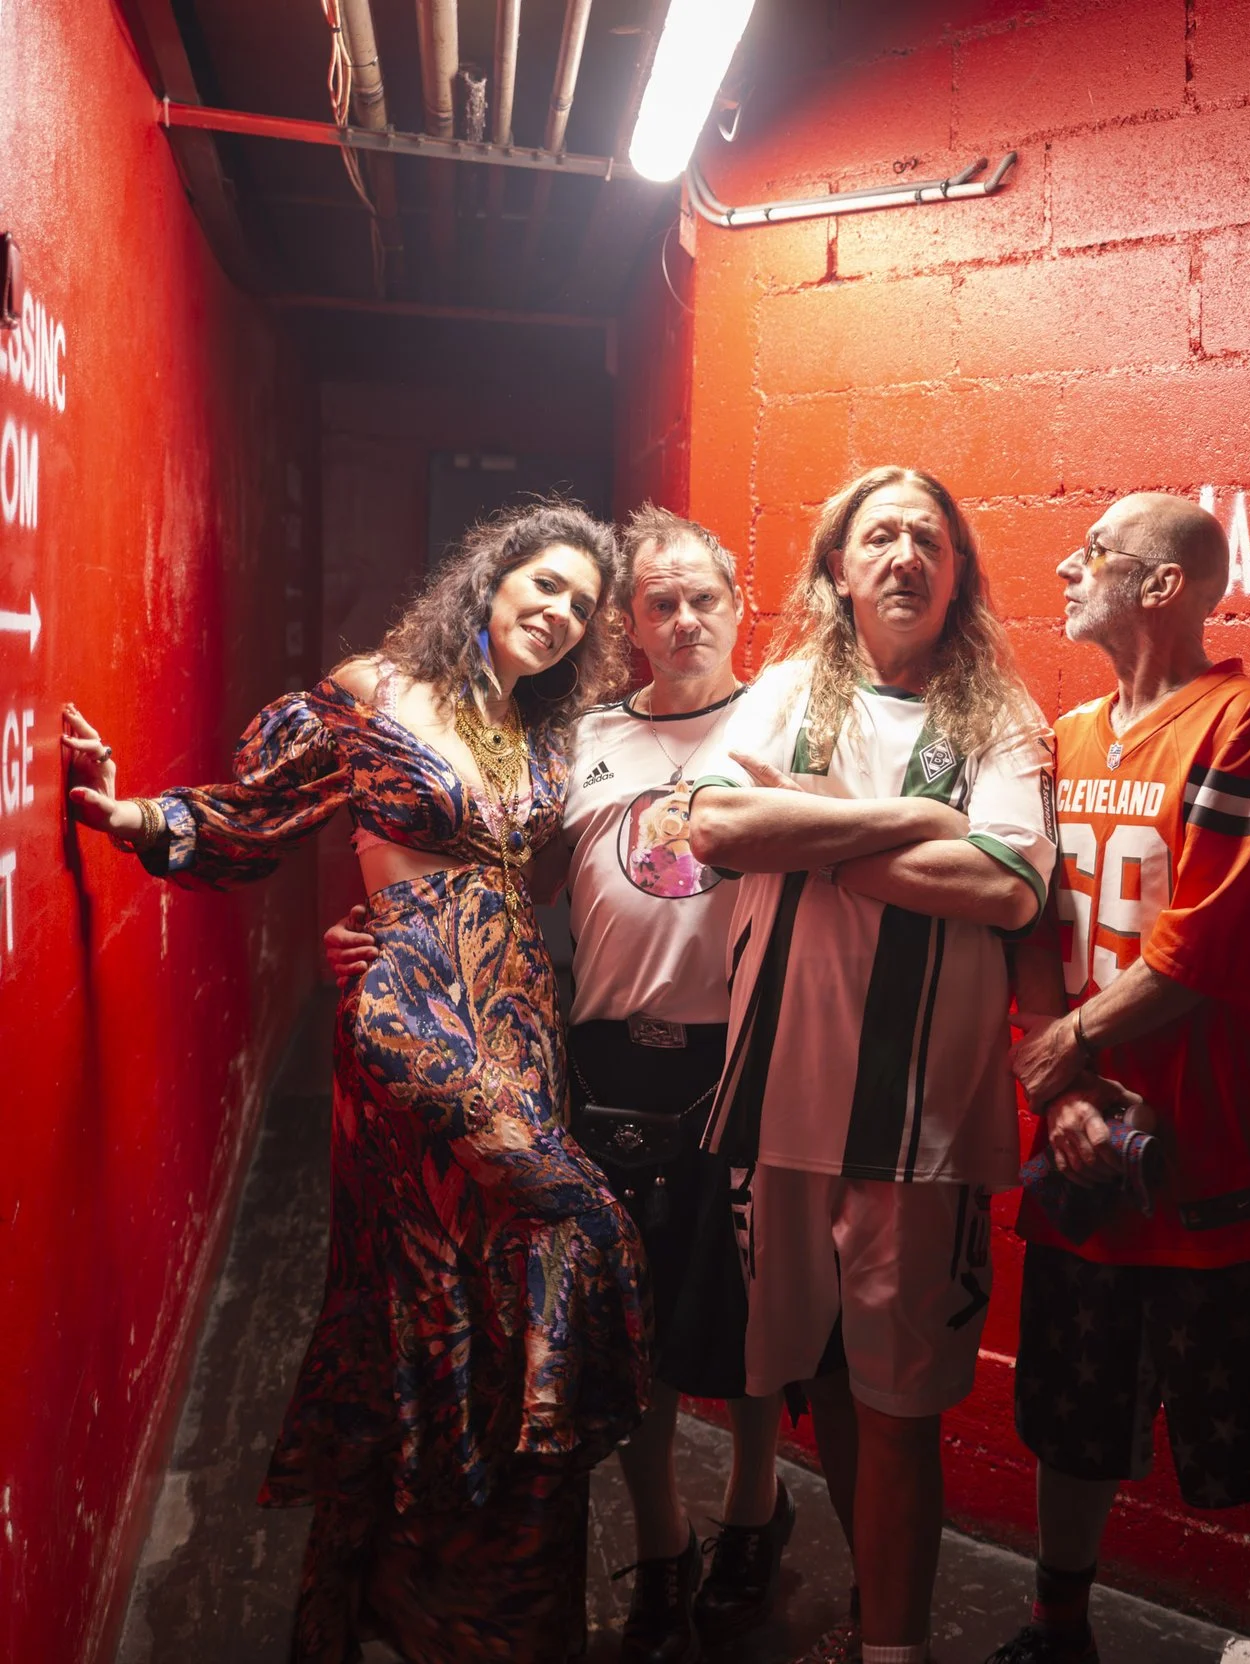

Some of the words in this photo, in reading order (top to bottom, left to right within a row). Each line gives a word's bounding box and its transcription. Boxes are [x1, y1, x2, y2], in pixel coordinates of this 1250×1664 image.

[0, 709, 35, 815] GE
[582, 772, 615, 789] adidas
[1057, 778, 1166, 817] CLEVELAND
[1055, 822, 1172, 1000] 69
